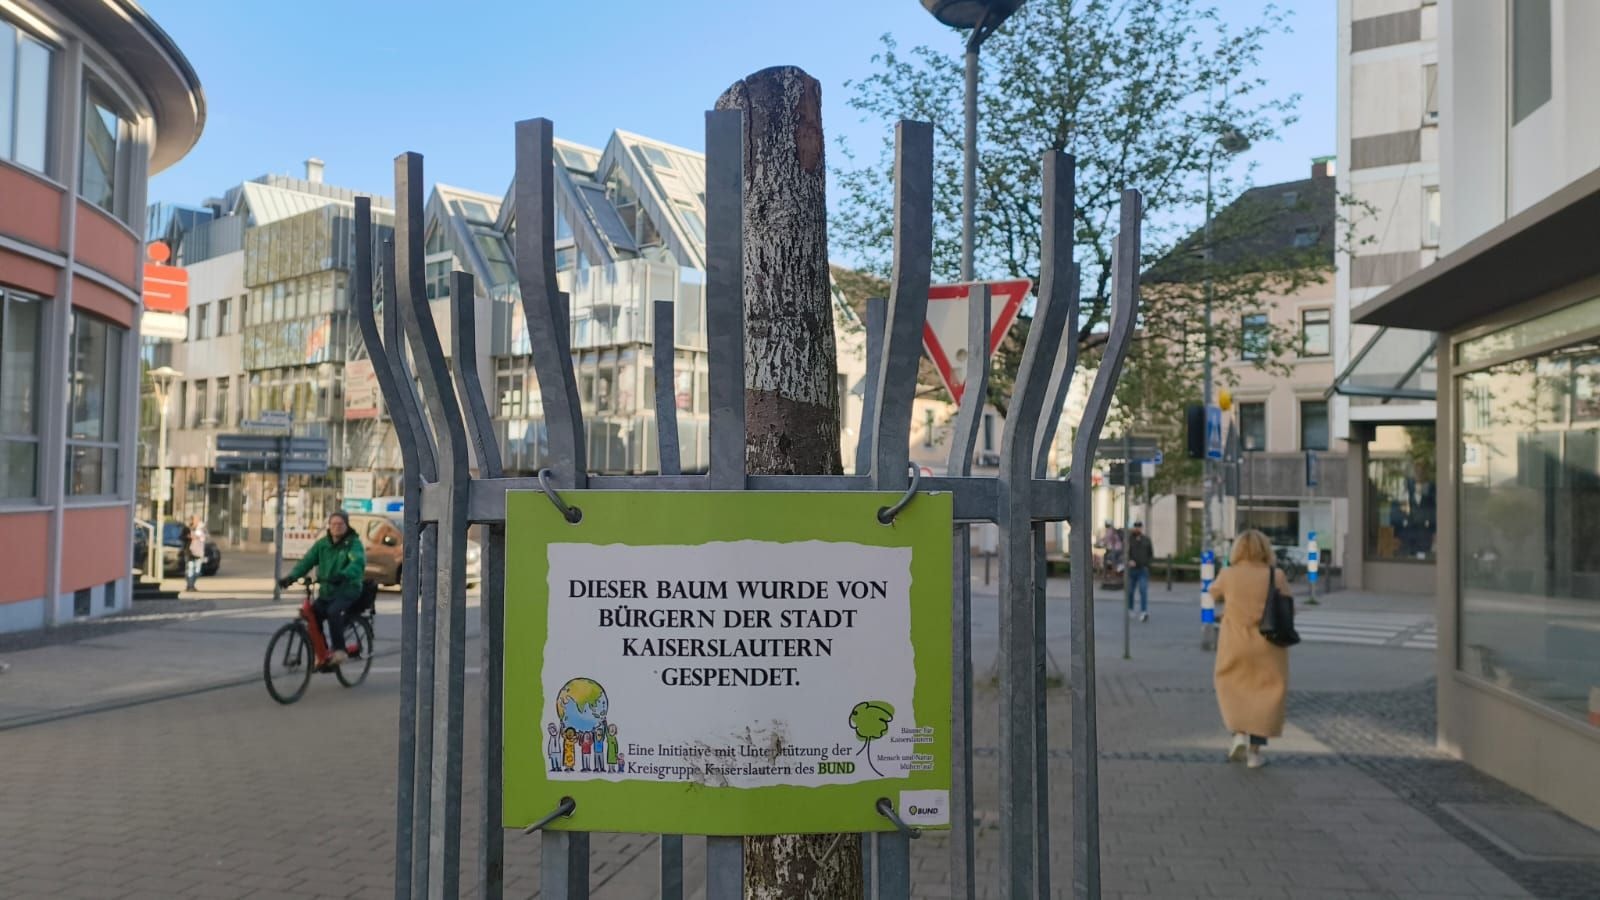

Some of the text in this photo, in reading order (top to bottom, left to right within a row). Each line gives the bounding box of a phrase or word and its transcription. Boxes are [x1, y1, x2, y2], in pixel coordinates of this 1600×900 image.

[568, 580, 888, 600] DIESER BAUM WURDE VON
[598, 605, 858, 628] BÜRGERN DER STADT
[622, 638, 832, 657] KAISERSLAUTERN
[661, 668, 800, 686] GESPENDET.
[628, 744, 852, 760] Eine Initiative mit Untertützung der
[628, 762, 856, 780] Kreisgruppe Kaiserslautern des BUND
